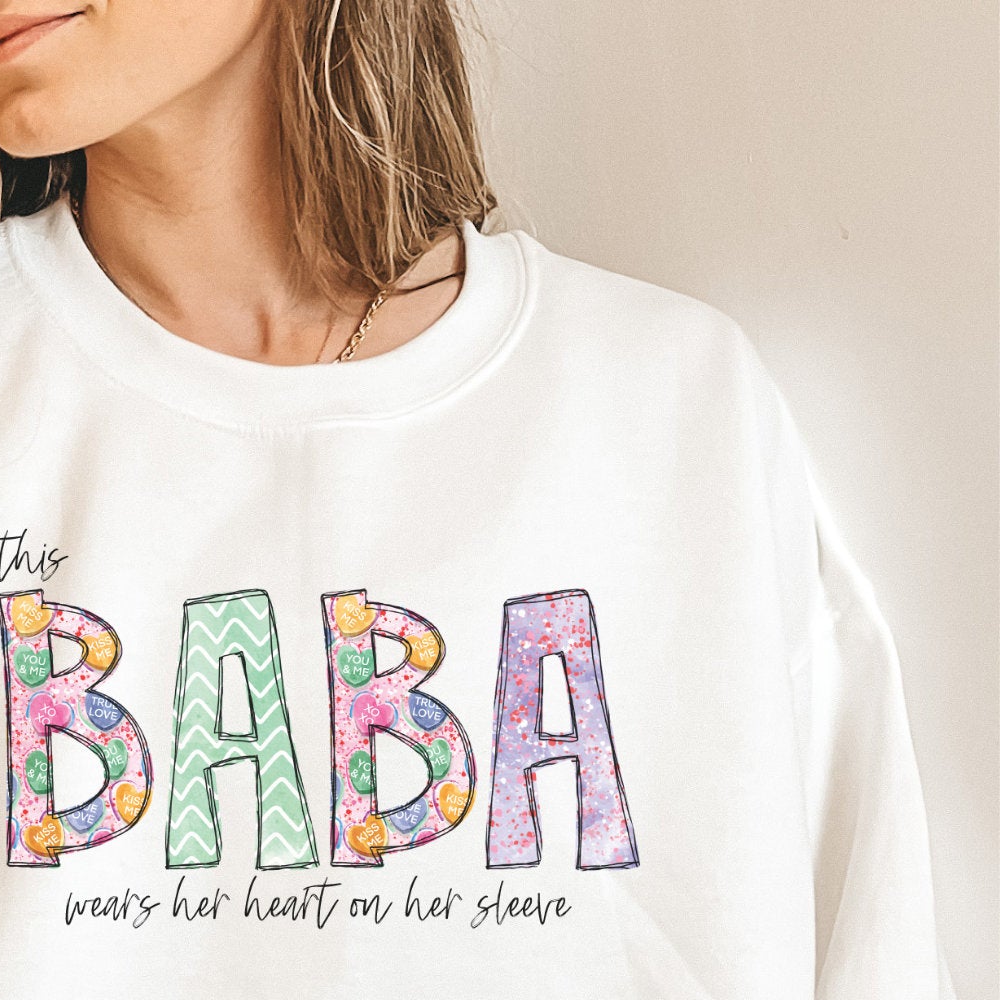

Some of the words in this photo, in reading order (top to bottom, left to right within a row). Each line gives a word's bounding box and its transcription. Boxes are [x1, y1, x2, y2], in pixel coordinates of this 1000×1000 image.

[20, 601, 43, 621] KISS
[343, 601, 366, 621] KISS
[17, 612, 34, 627] ME
[340, 612, 357, 627] ME
[90, 636, 114, 650] KISS
[413, 636, 437, 650] KISS
[22, 653, 47, 665] YOU
[95, 650, 114, 660] ME
[345, 653, 370, 665] YOU
[418, 650, 437, 660] ME
[29, 666, 47, 677] ME
[352, 666, 370, 677] ME
[89, 708, 119, 721] LOVE
[412, 708, 442, 721] LOVE
[33, 823, 57, 844] KISS
[356, 823, 380, 844] KISS
[65, 888, 160, 929] wears
[172, 875, 231, 921] her
[245, 875, 342, 930] heart
[350, 895, 393, 924] on
[405, 875, 463, 920] her
[471, 880, 572, 929] sleeve
